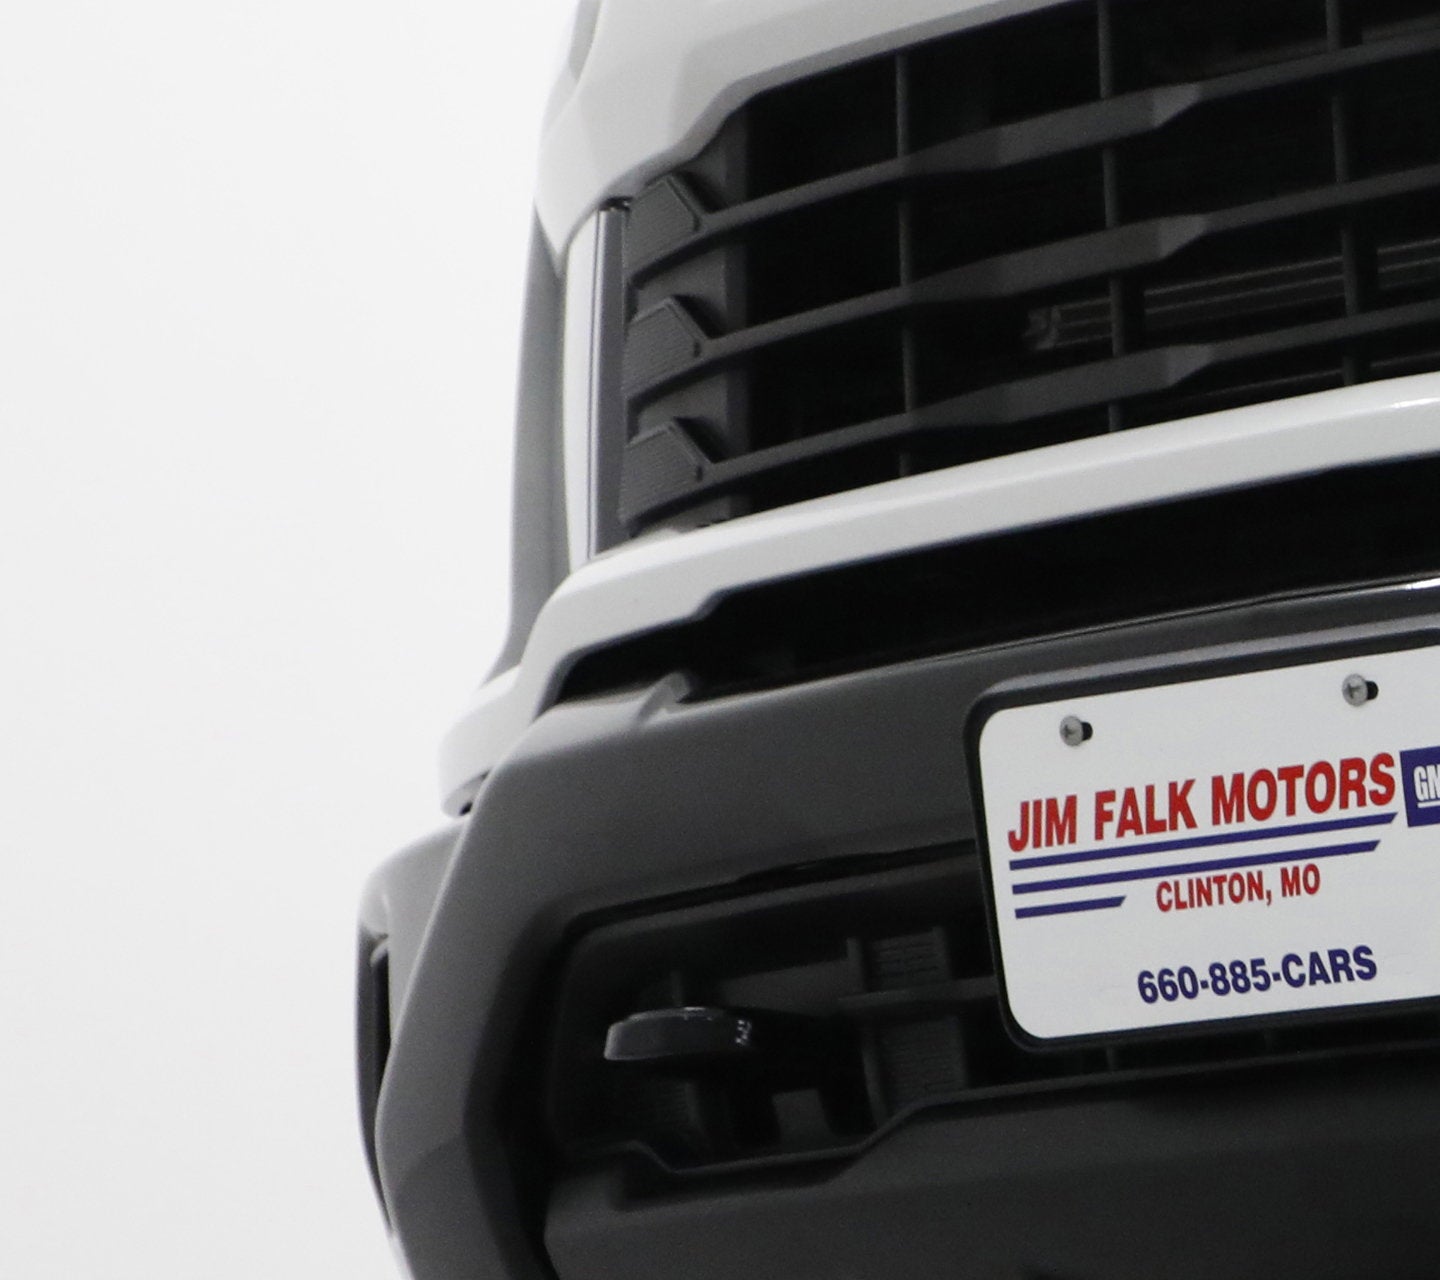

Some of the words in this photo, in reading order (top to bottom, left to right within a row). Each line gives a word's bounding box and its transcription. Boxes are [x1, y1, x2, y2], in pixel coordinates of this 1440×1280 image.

[1008, 795, 1077, 852] JIM
[1095, 779, 1197, 840] FALK
[1211, 753, 1396, 826] MOTORS
[1156, 873, 1273, 912] CLINTON,
[1281, 864, 1321, 897] MO
[1137, 945, 1378, 1004] 660-885-CARS
